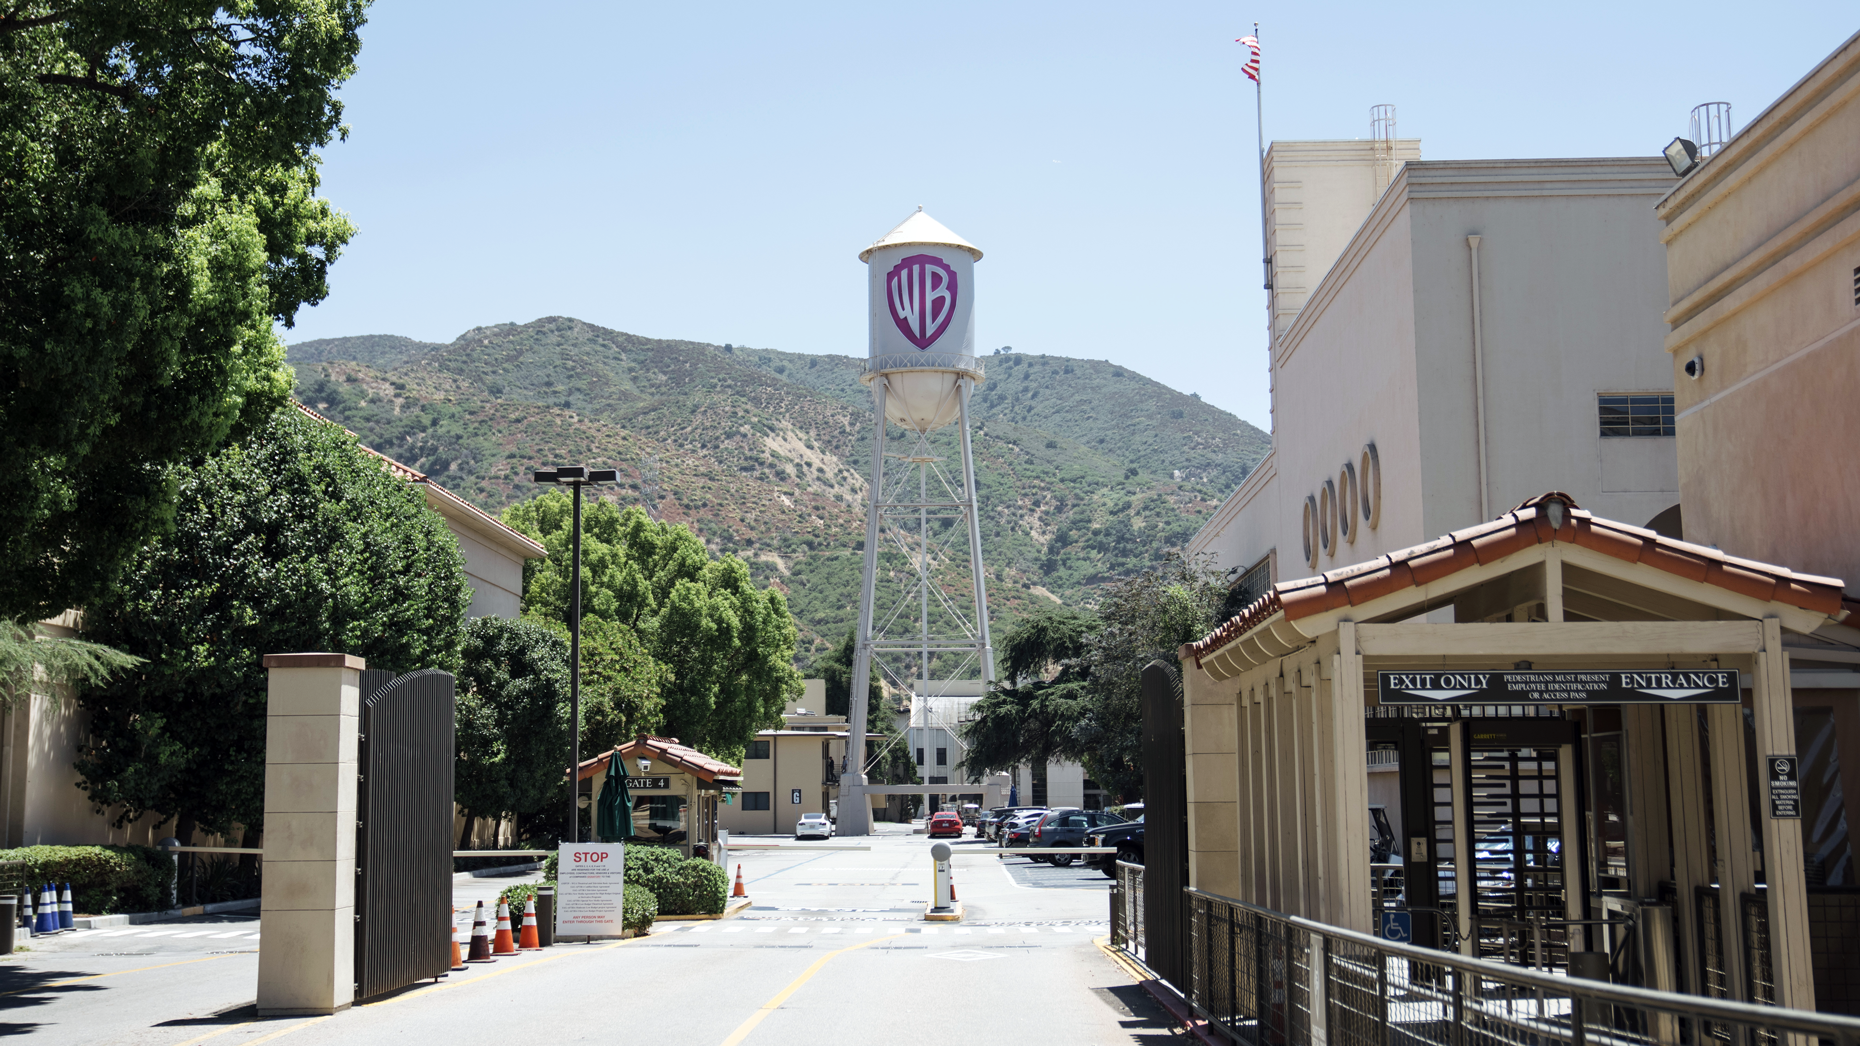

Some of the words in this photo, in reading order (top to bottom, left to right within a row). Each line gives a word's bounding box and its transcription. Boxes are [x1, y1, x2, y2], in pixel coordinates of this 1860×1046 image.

[891, 263, 952, 340] WB
[1389, 674, 1435, 689] EXIT
[1440, 674, 1490, 689] ONLY
[1503, 674, 1554, 682] PEDESTRIANS
[1554, 674, 1576, 682] MUST
[1577, 674, 1610, 682] PRESENT
[1620, 673, 1729, 688] ENTRANCE
[1507, 683, 1546, 691] EMPLOYEE
[1547, 683, 1608, 691] IDENTIFICATION
[624, 778, 653, 788] GATE
[658, 778, 664, 788] 4
[793, 792, 800, 804] G
[573, 851, 609, 863] STOP
